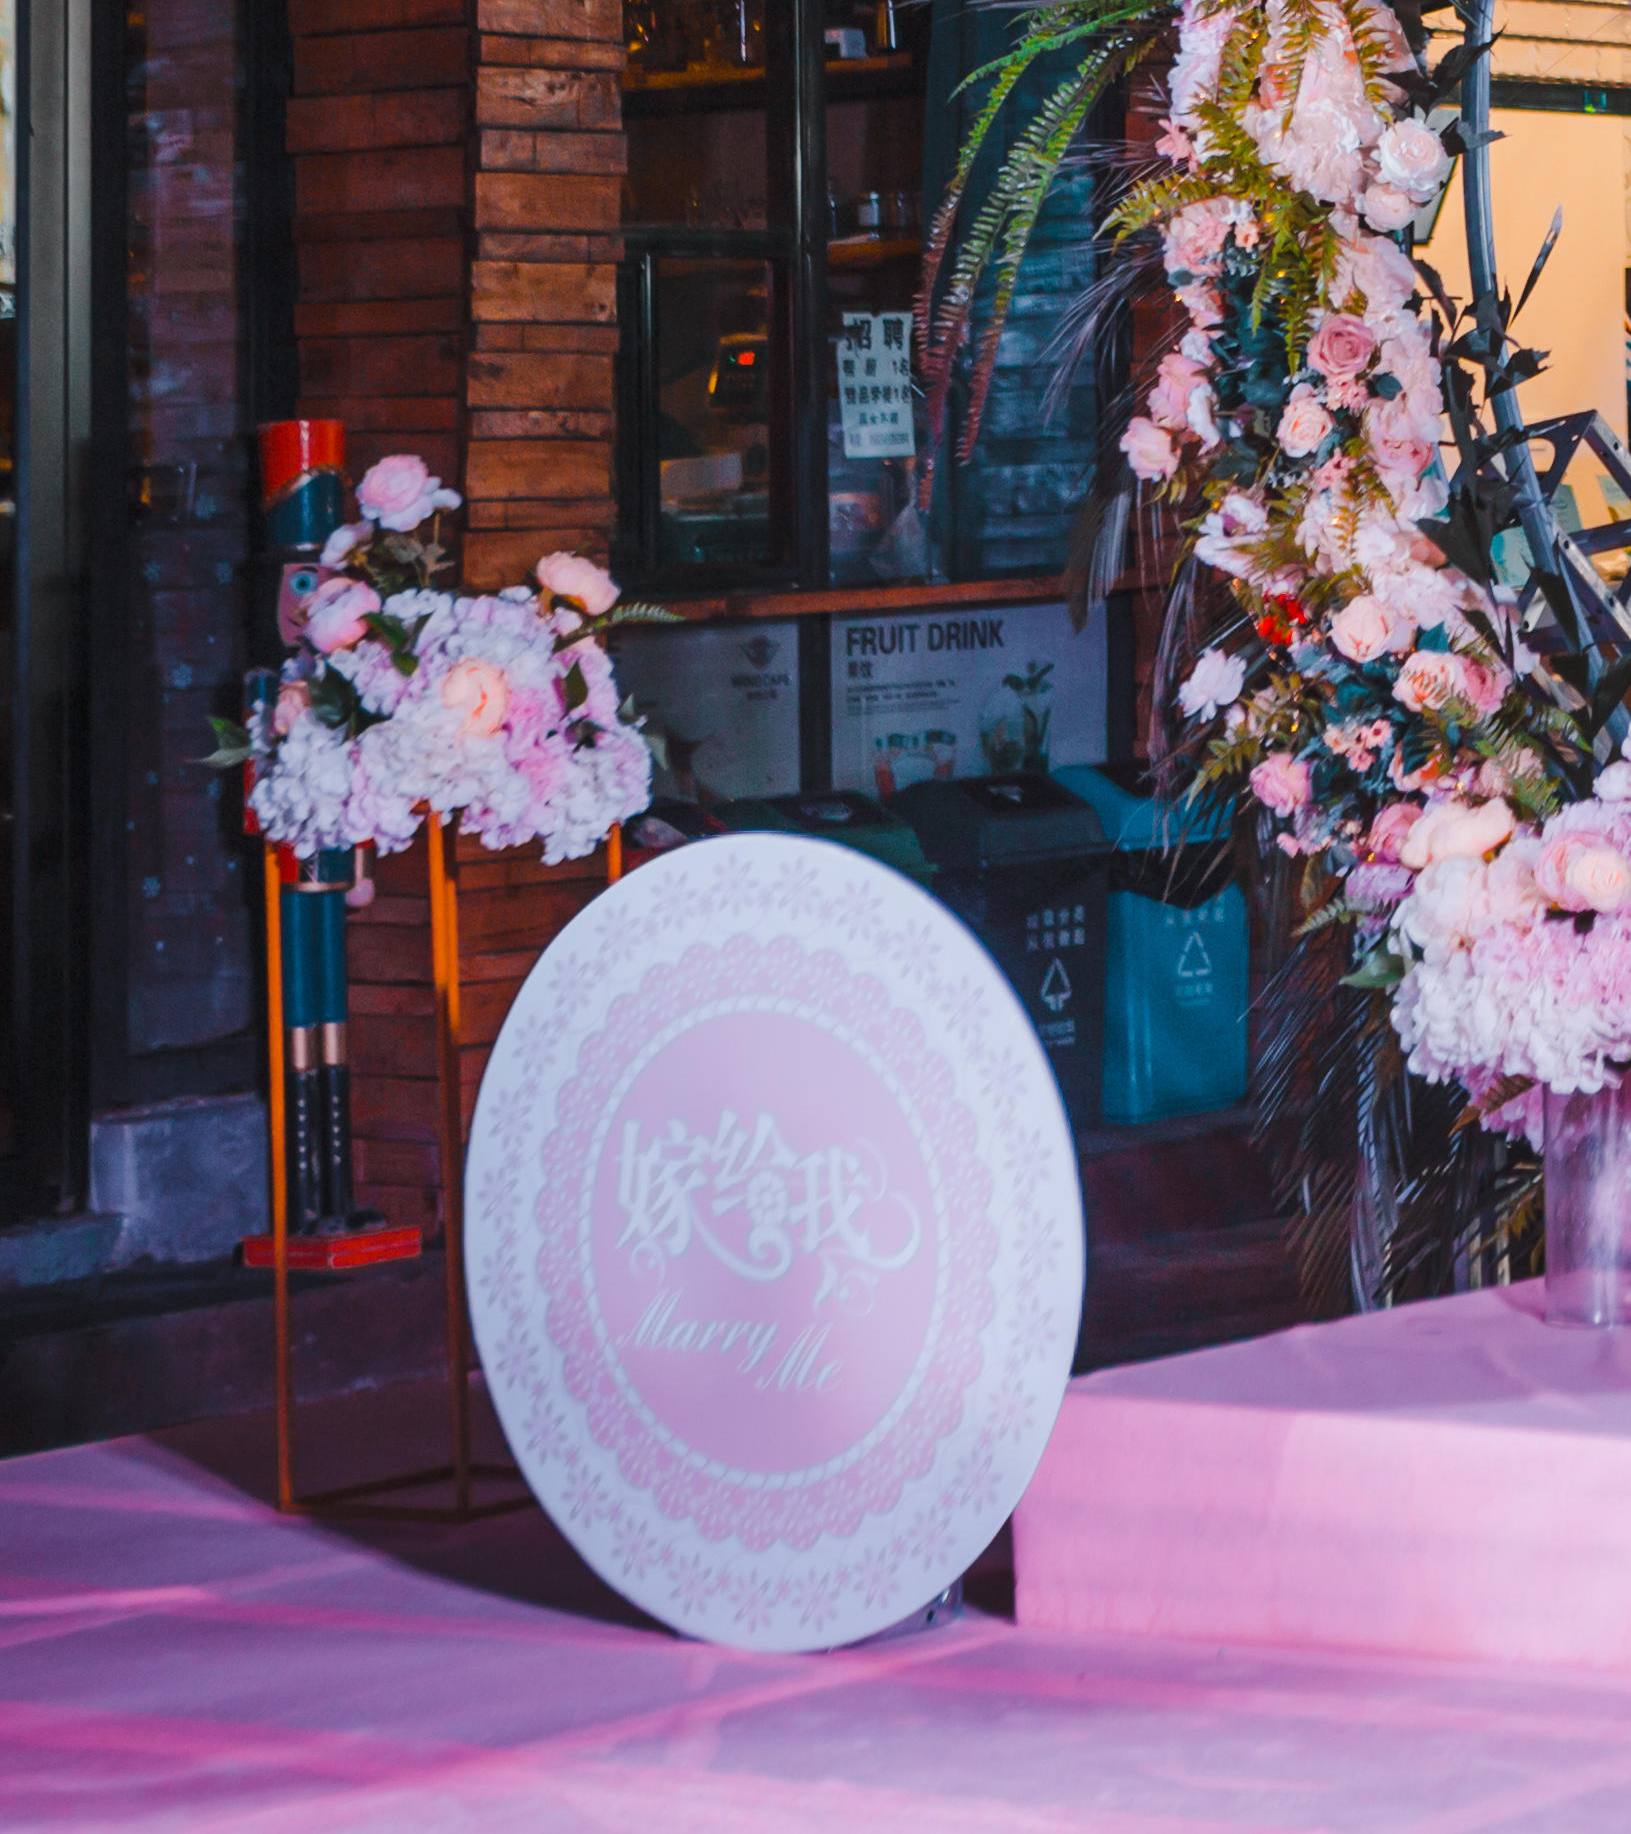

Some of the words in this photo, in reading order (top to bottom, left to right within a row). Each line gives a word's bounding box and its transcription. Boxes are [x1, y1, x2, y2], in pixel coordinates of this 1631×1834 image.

[846, 624, 921, 657] FRUIT
[927, 619, 1005, 652] DRINK
[615, 1286, 780, 1375] Marry
[754, 1321, 844, 1392] Me
